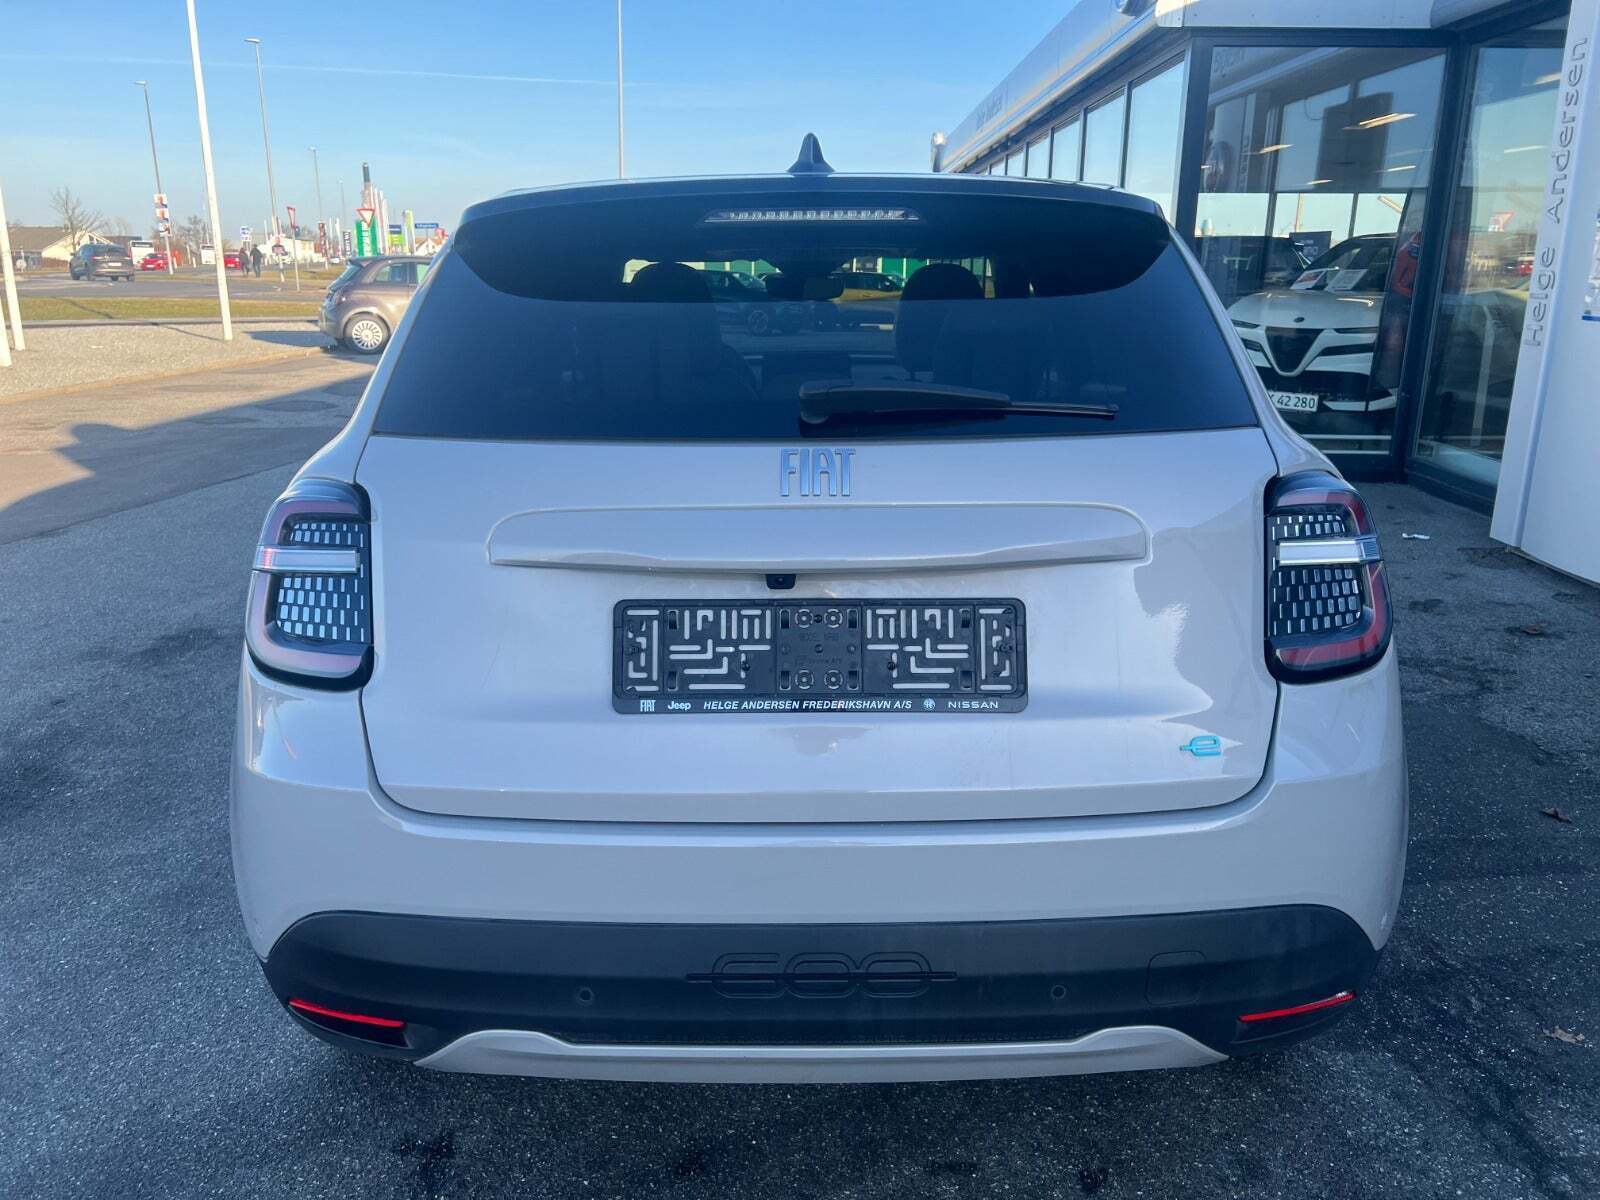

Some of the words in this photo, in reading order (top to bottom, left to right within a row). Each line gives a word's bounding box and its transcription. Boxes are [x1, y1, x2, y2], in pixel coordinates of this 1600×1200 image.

[1524, 247, 1556, 346] Helge
[1547, 37, 1588, 224] Andersen
[1277, 395, 1291, 407] 42
[1294, 396, 1316, 409] 280
[780, 447, 856, 497] FIAT
[640, 700, 656, 712] FIAT
[667, 701, 691, 711] Jeep
[703, 701, 739, 710] HELGE
[741, 700, 800, 710] ANDERSEN
[802, 700, 891, 710] FREDERIKSHAVN
[893, 700, 913, 710] A/S
[948, 701, 999, 709] NISSAN
[711, 951, 933, 1000] 600
